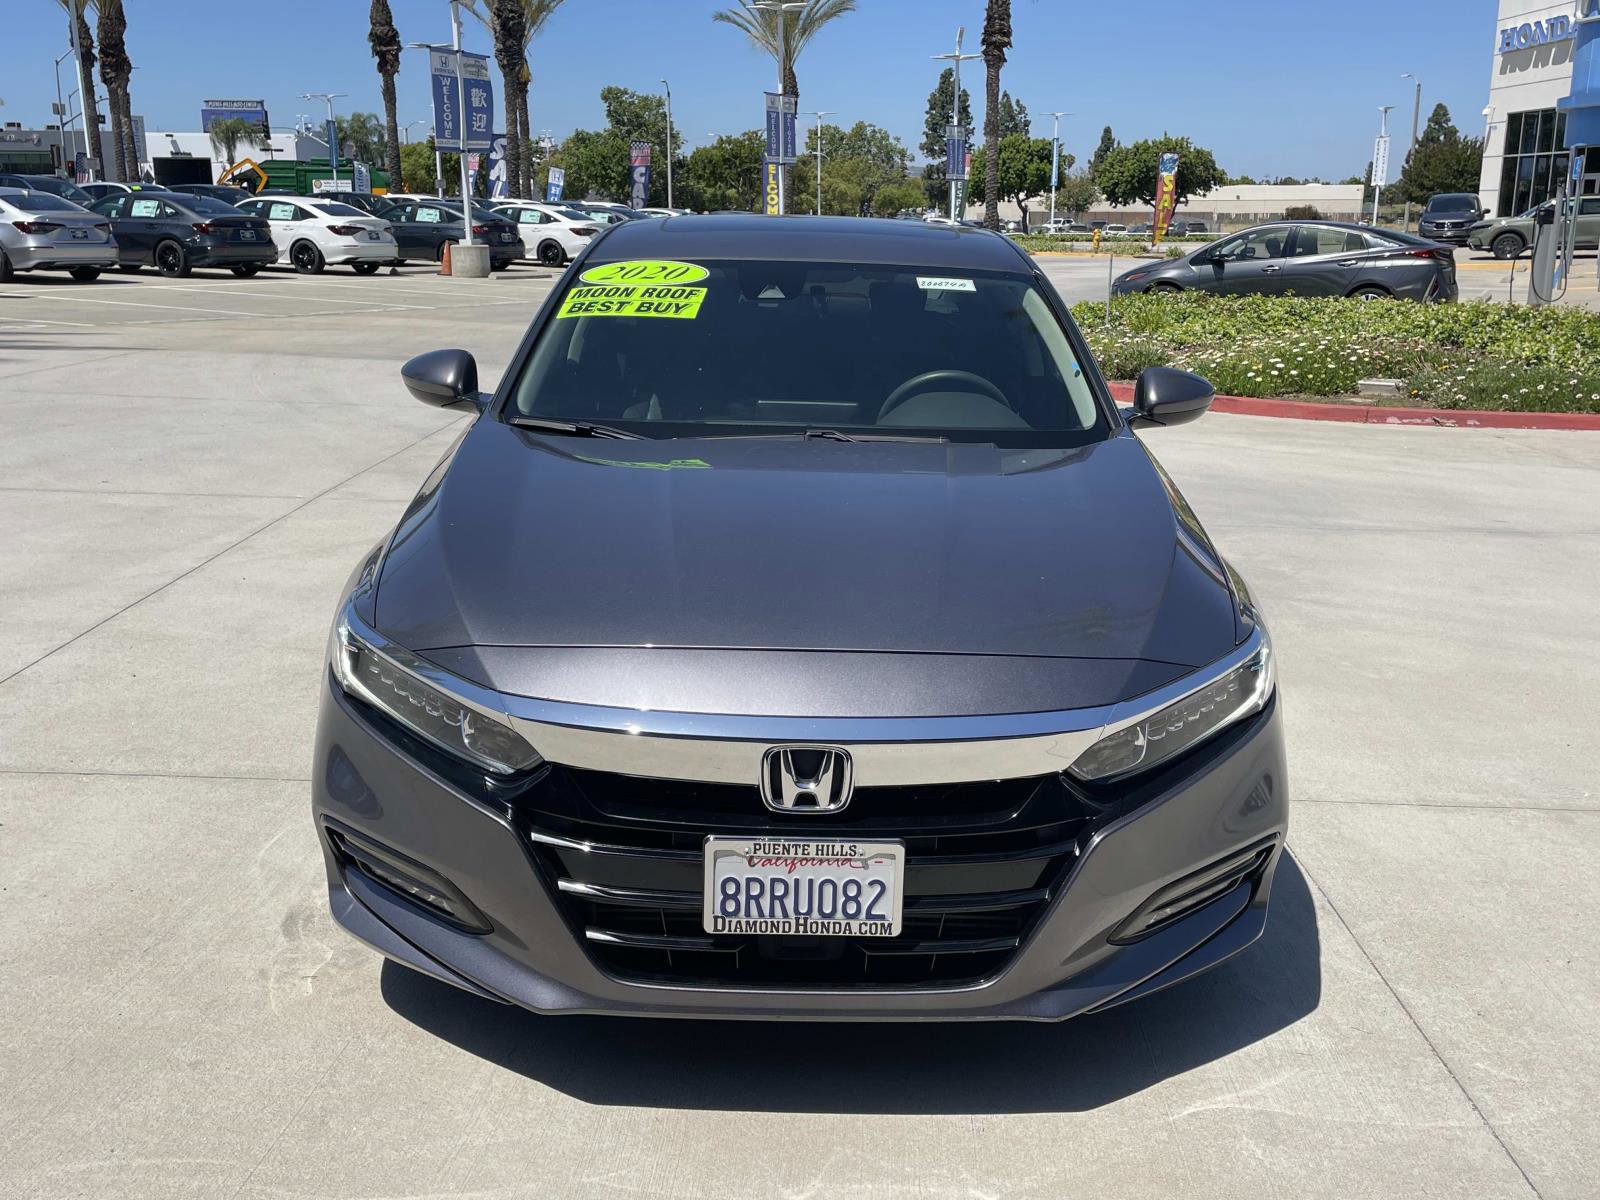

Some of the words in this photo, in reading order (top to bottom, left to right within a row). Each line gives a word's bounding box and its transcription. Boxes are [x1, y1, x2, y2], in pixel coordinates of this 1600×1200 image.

[440, 76, 453, 138] WELCOME
[471, 88, 487, 132] 歡迎
[769, 112, 777, 156] WELCOME
[598, 265, 690, 280] 2020
[571, 287, 637, 300] MOON
[640, 287, 701, 300] ROOF
[566, 301, 632, 314] BEST
[634, 301, 690, 315] BUY
[753, 842, 810, 857] PUENTE
[815, 844, 857, 858] HILLS
[747, 856, 866, 874] California
[719, 876, 887, 920] 8RRU082
